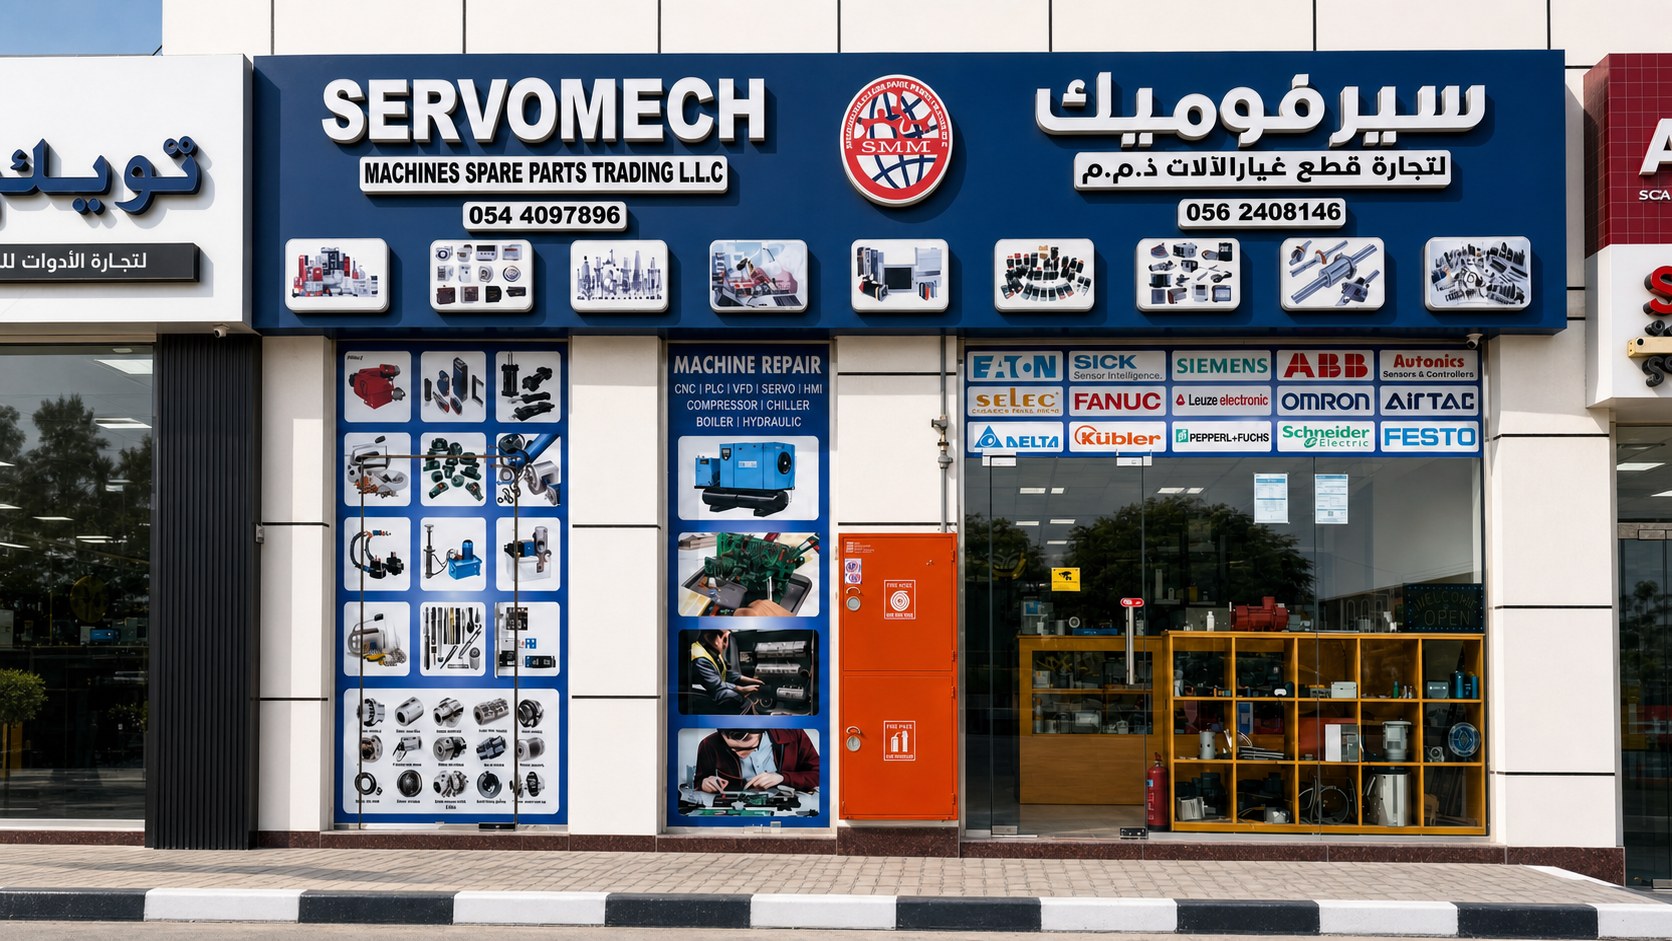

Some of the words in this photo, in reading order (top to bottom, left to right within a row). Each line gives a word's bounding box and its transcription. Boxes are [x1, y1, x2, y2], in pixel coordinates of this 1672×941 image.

[321, 76, 766, 144] SERVOMECH
[1036, 71, 1486, 148] سيرفوميك
[861, 140, 931, 153] SMM
[1638, 117, 1672, 176] A
[364, 161, 460, 185] MACHINES
[465, 161, 524, 184] SPARE
[528, 161, 587, 184] PARTS
[592, 161, 674, 183] TRADING
[679, 161, 724, 183] L.L.C
[1081, 157, 1158, 184] ذ.م.م
[1296, 155, 1361, 183] قطع
[1372, 154, 1446, 181] لتجارة
[1638, 189, 1672, 201] SCA
[468, 206, 513, 225] 054
[519, 206, 621, 225] 4097896
[1186, 203, 1231, 222] 056
[1238, 202, 1342, 222] 2408146
[21, 250, 85, 273] الأدوات
[673, 355, 756, 375] MACHINE
[761, 355, 822, 374] REPAIR
[973, 355, 1057, 378] EATON
[1073, 354, 1137, 369] SICK
[1176, 358, 1268, 374] SIEMENS
[1283, 353, 1369, 378] ABB
[1393, 354, 1465, 368] Autonics
[1073, 371, 1106, 380] Sensor
[1383, 370, 1417, 378] Sensors
[1426, 370, 1475, 378] Controllers
[674, 383, 696, 394] CNC
[705, 383, 725, 394] PLC
[732, 383, 753, 394] VFD
[761, 383, 796, 394] SERVO
[803, 383, 823, 394] HMI
[686, 399, 758, 411] COMPRESSOR
[766, 400, 810, 411] CHILLER
[1074, 392, 1162, 411] FANUC
[1188, 393, 1218, 406] Leuze
[1219, 393, 1269, 406] electronic
[1281, 392, 1370, 411] OMRON
[696, 416, 734, 427] BOILER
[742, 416, 802, 427] HYDRAULIC
[1080, 426, 1162, 446] Kübler
[1189, 432, 1270, 442] PEPPERL+FUCHS
[1282, 425, 1370, 439] Schneider
[1384, 427, 1476, 446] FESTO
[1006, 436, 1059, 448] DELTA
[1319, 438, 1369, 448] Electric
[1424, 609, 1471, 626] OPEN
